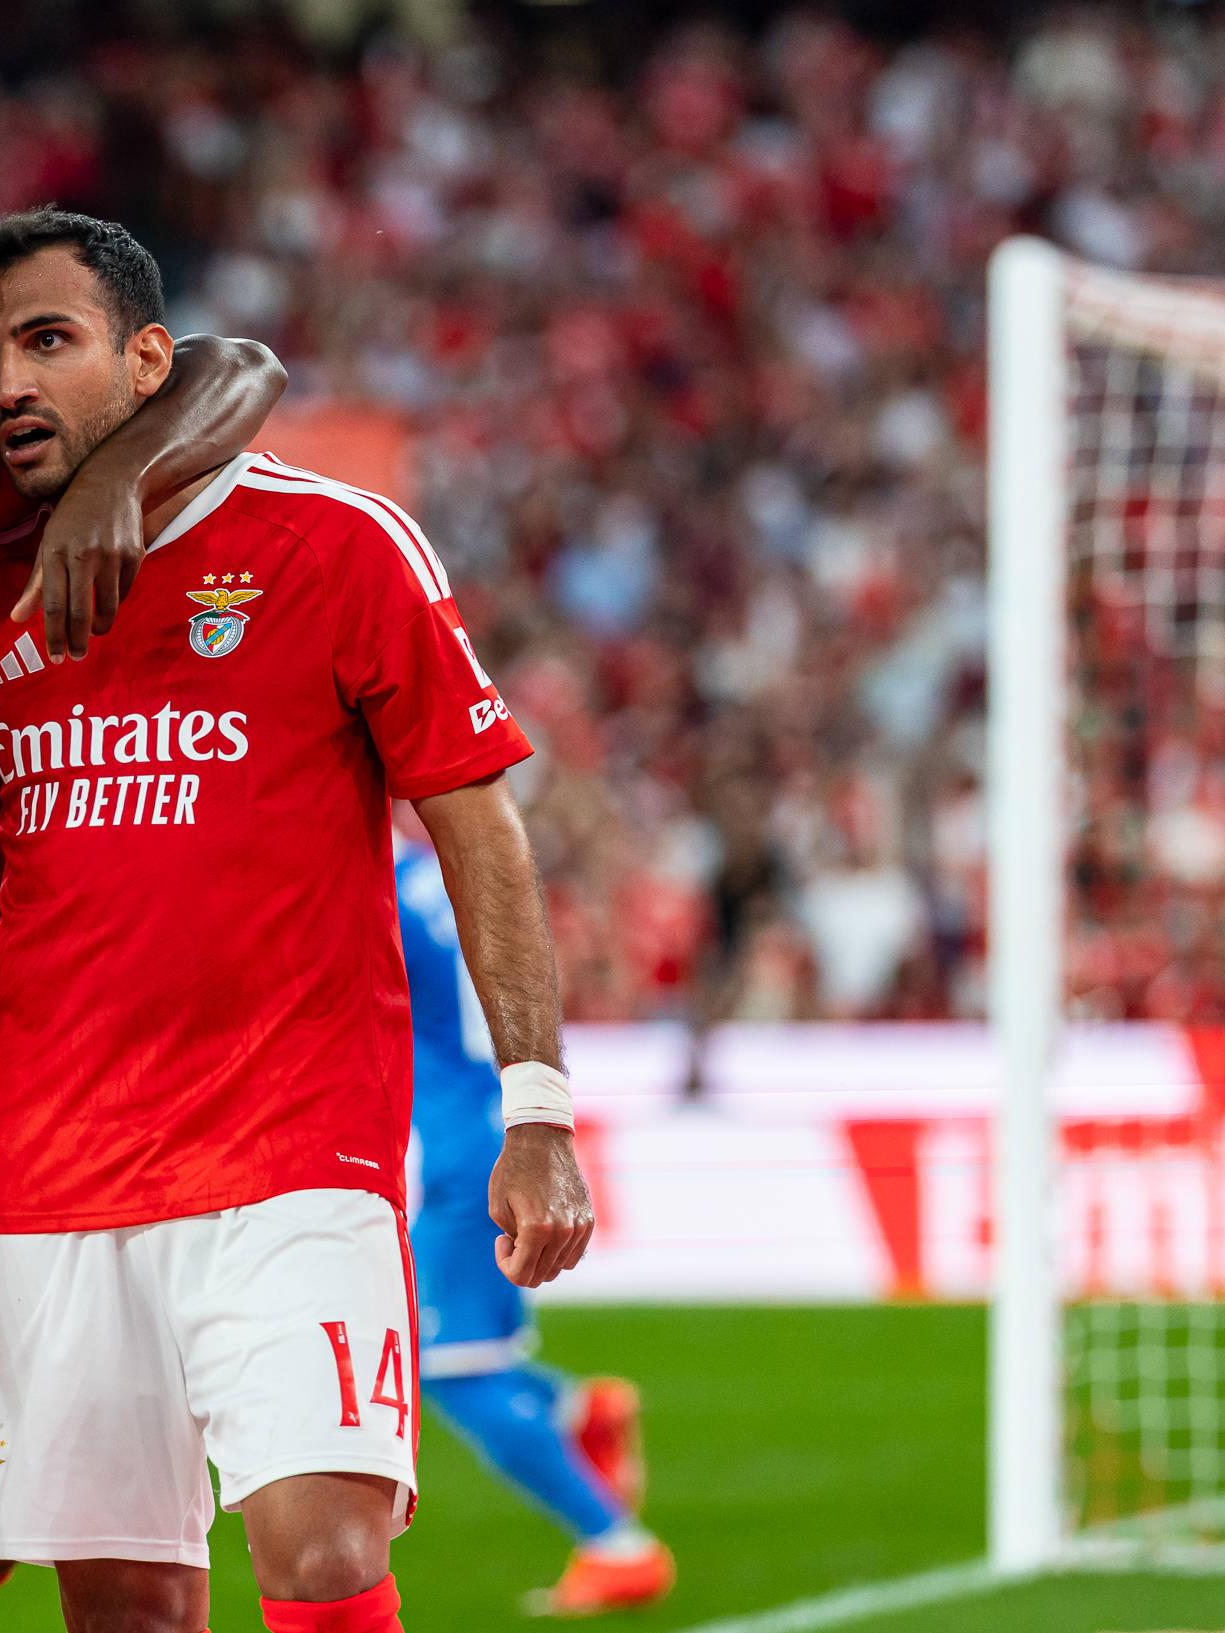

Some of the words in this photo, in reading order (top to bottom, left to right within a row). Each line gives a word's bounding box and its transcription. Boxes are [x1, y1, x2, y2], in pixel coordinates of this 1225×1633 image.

[16, 782, 60, 836] FLY
[65, 774, 200, 829] BETTER
[319, 1320, 409, 1440] 14
